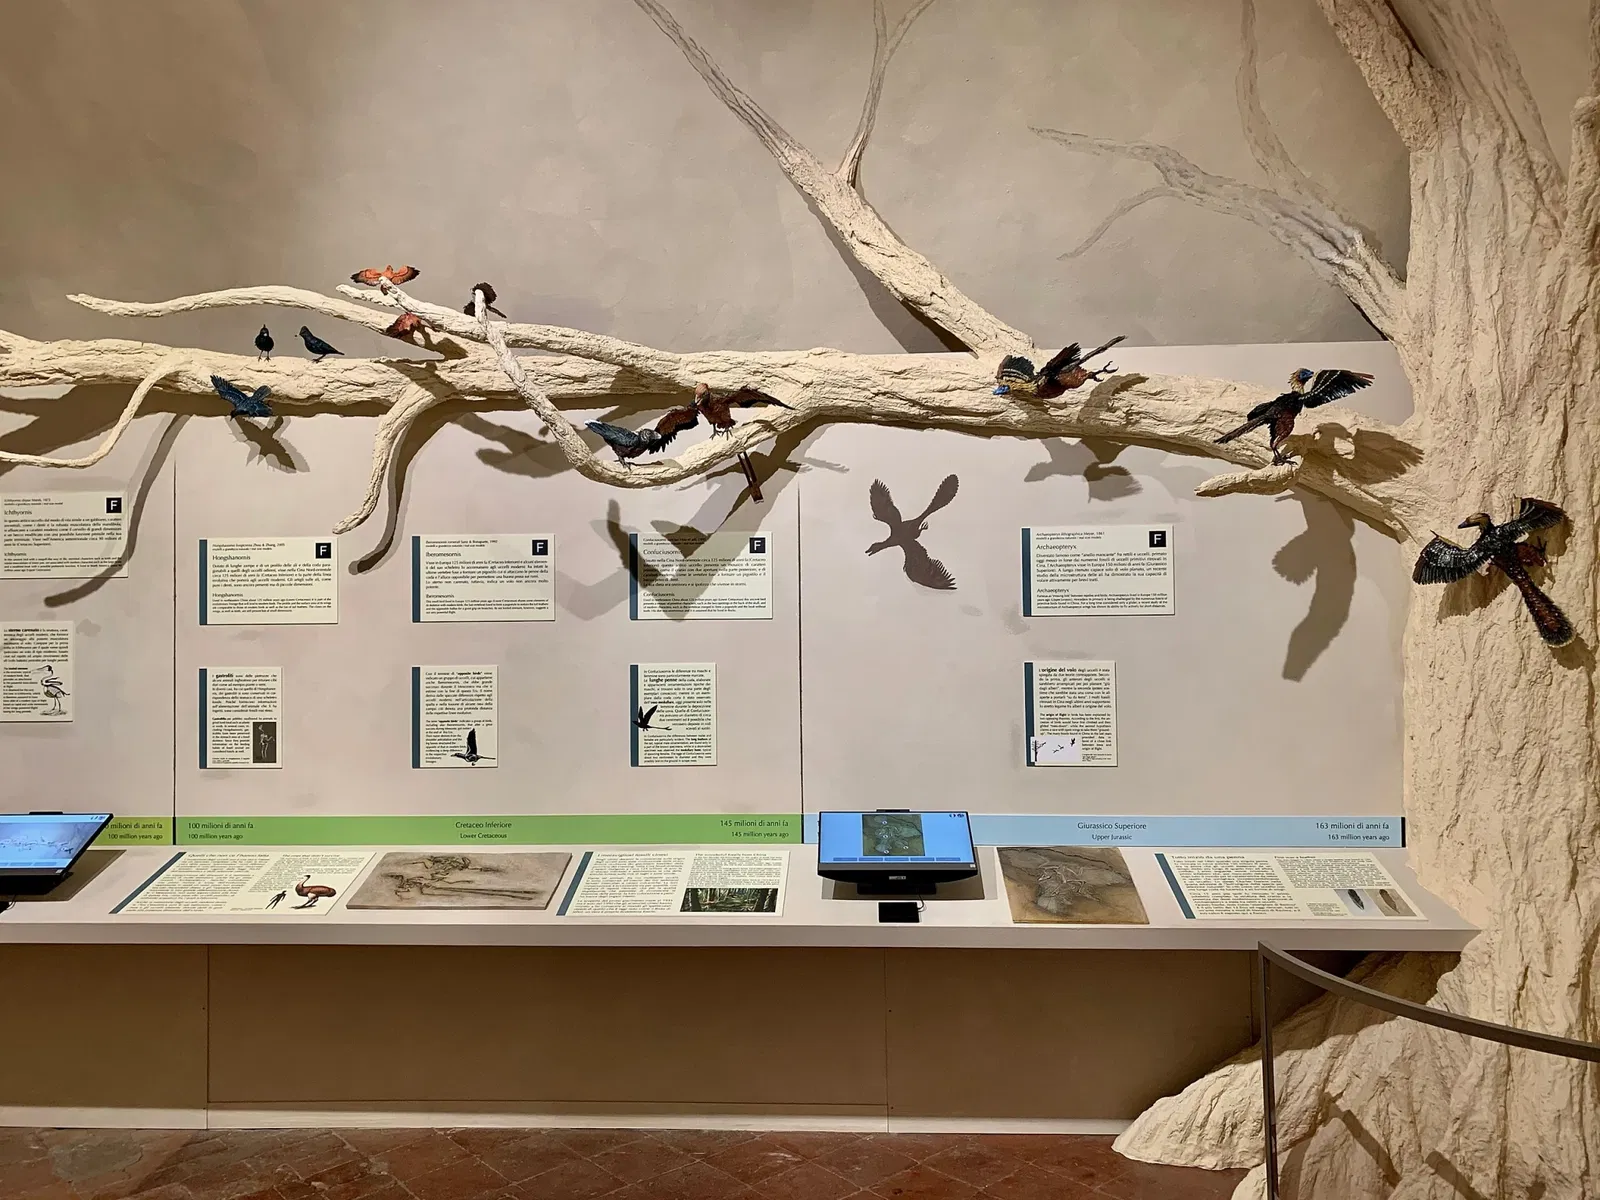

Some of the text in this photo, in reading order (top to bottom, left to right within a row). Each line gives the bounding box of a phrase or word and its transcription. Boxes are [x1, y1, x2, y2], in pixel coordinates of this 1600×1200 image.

[110, 500, 118, 510] F
[1154, 534, 1162, 544] F
[320, 545, 328, 556] F
[536, 542, 544, 552] F
[754, 540, 762, 551] F
[1114, 822, 1147, 831] Superiore
